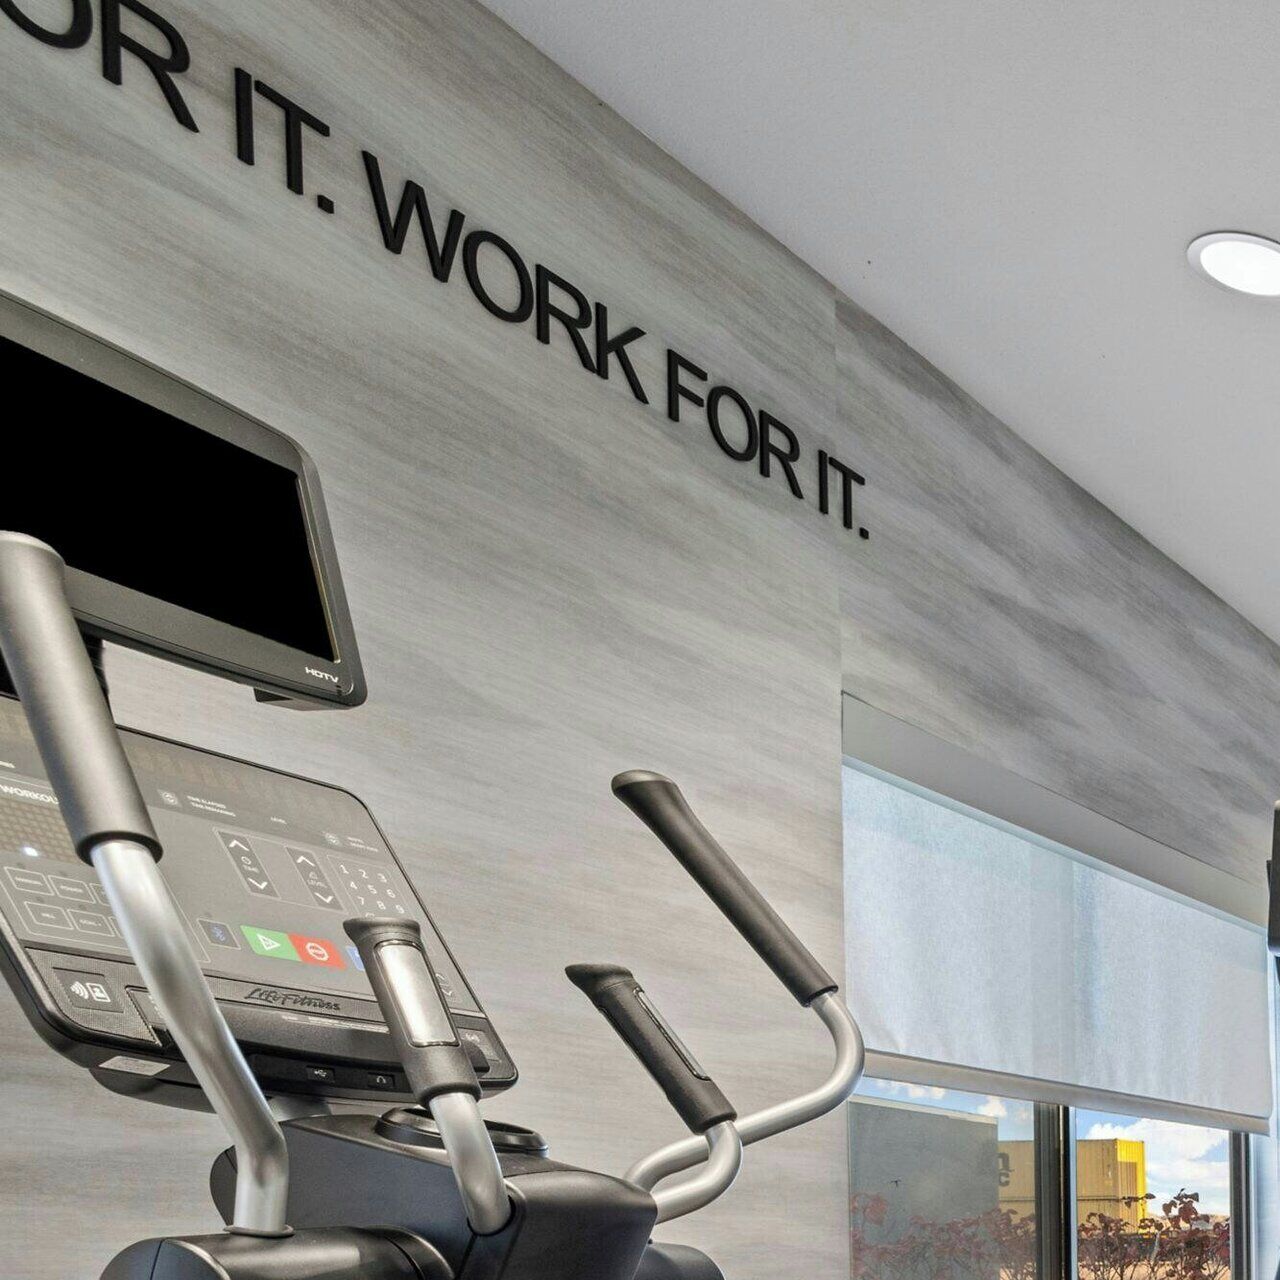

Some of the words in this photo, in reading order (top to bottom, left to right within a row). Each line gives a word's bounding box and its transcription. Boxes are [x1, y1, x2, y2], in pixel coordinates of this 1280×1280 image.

[234, 67, 334, 214] IT.
[361, 150, 649, 405] WORK
[667, 348, 803, 500] FOR
[819, 450, 870, 540] IT.
[305, 666, 339, 683] HDTV
